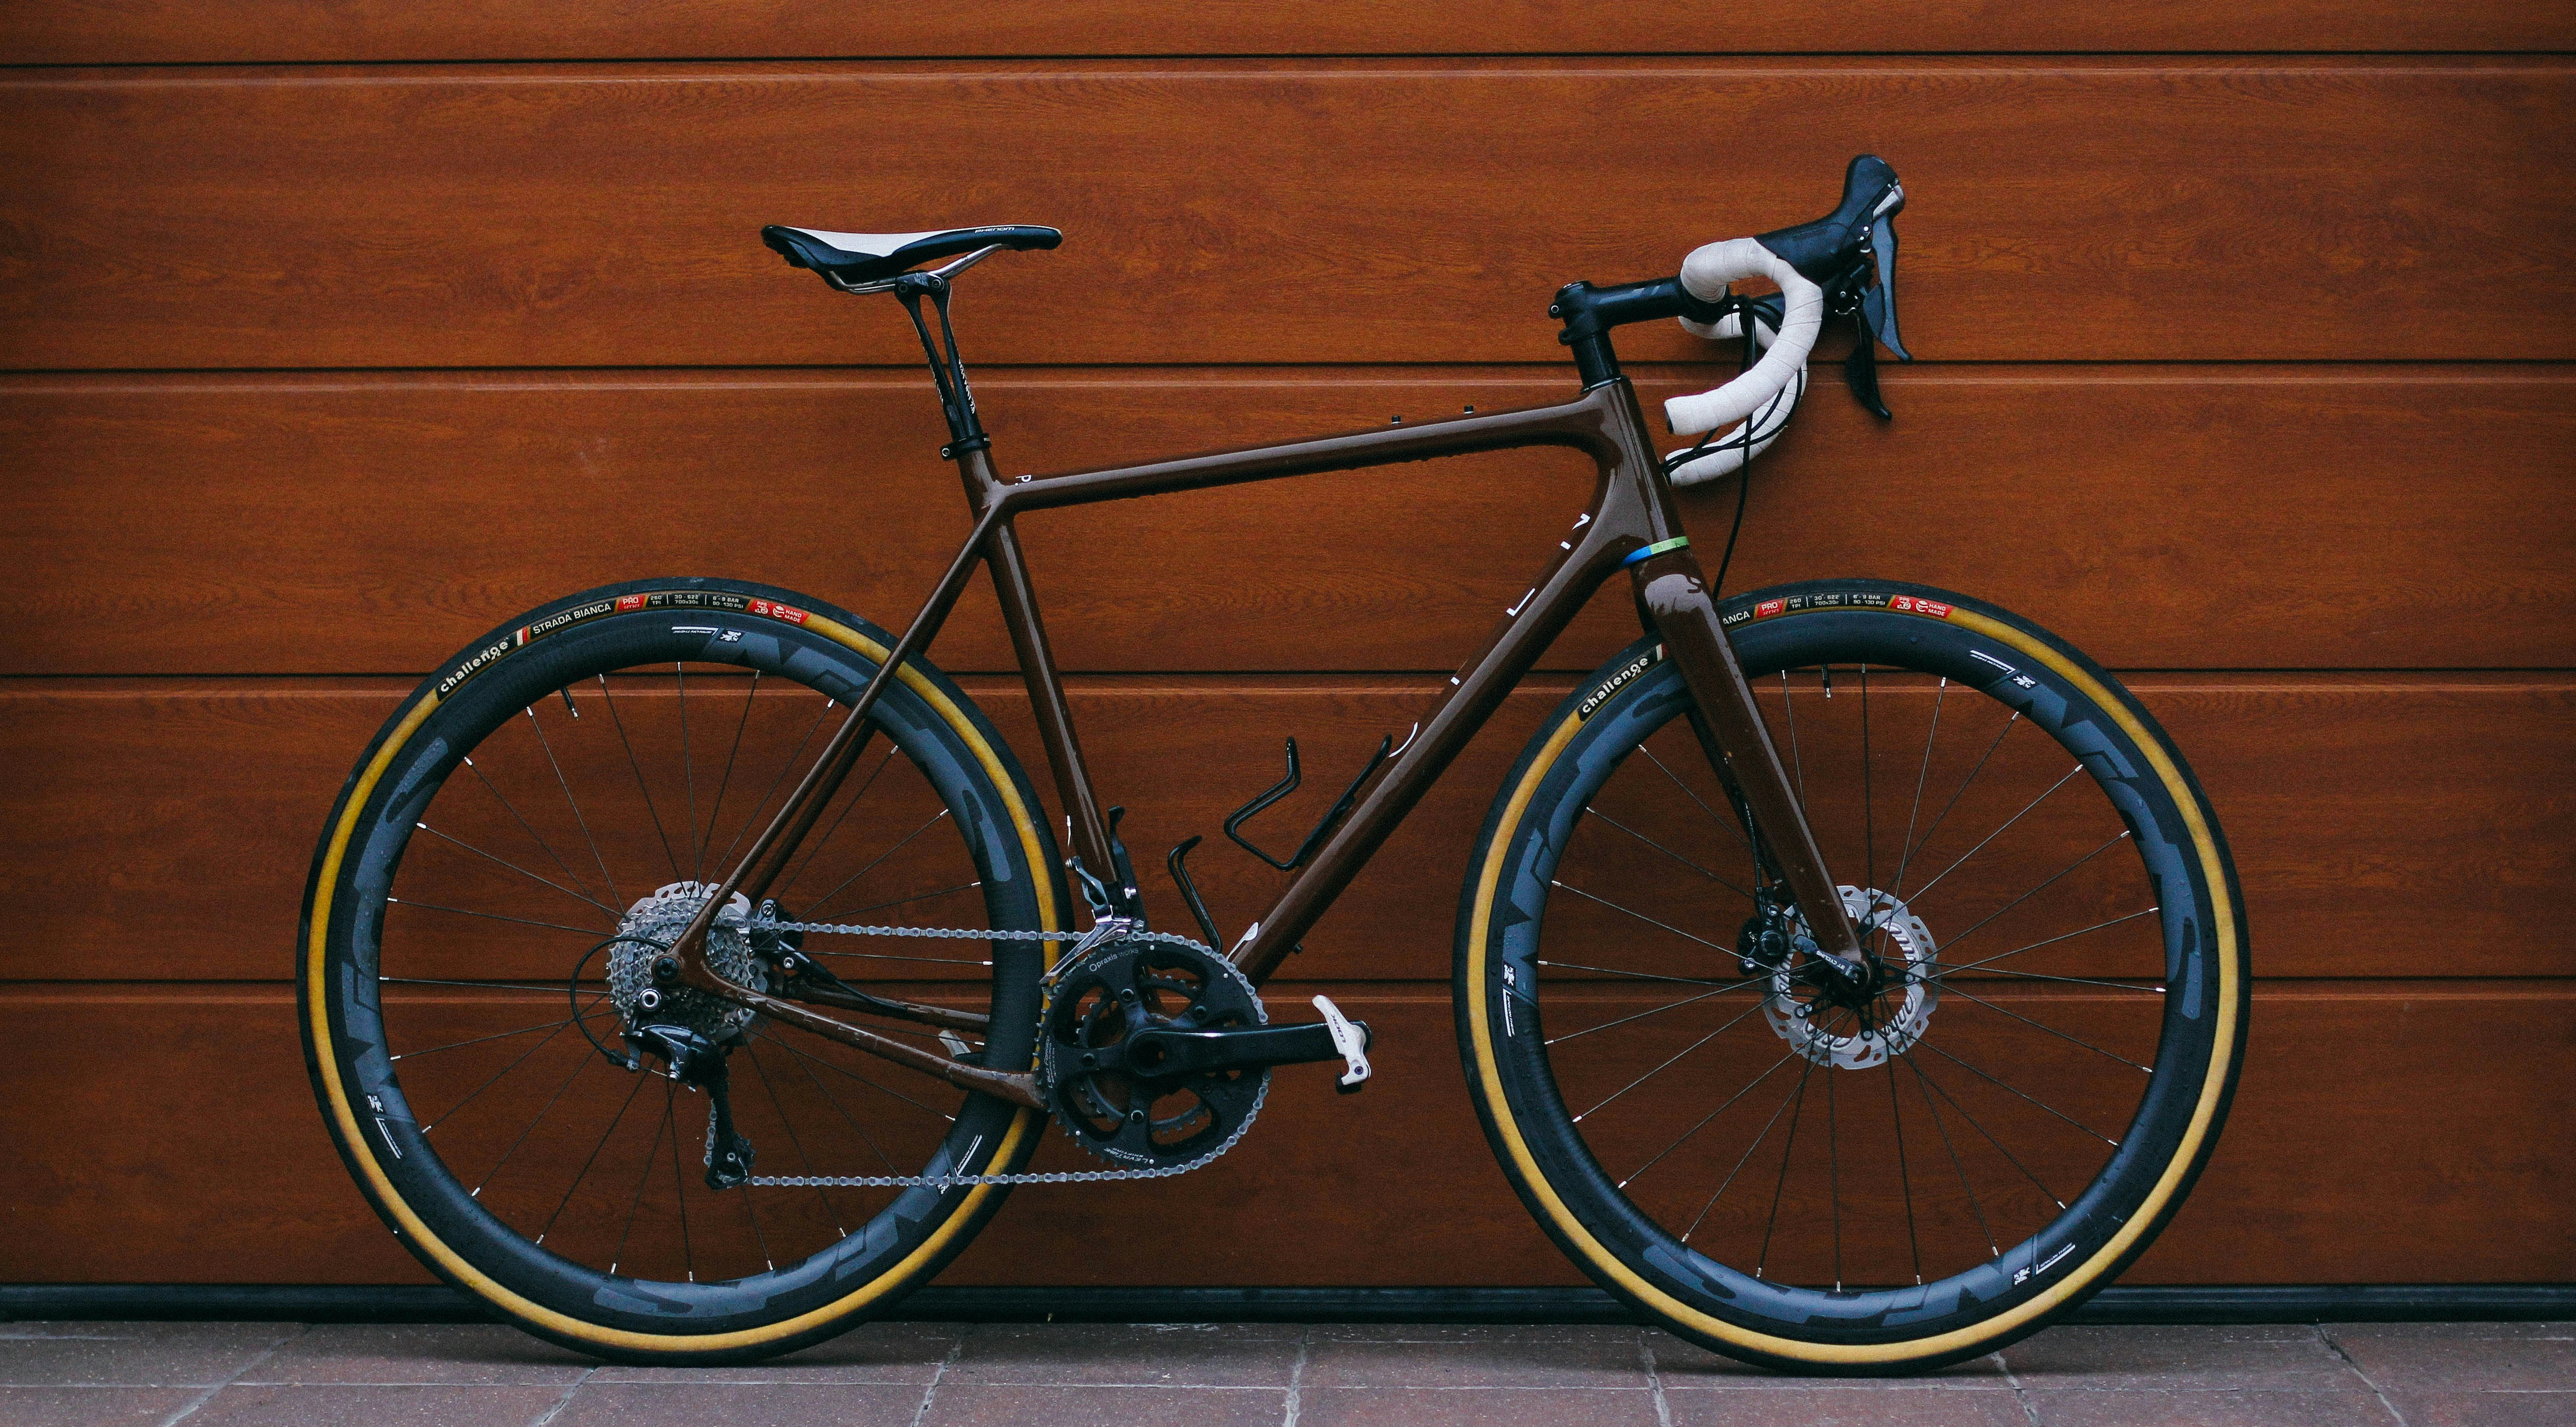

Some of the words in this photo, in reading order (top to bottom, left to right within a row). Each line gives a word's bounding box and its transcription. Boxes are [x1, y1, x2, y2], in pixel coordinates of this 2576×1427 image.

[623, 597, 639, 605] PRO
[1761, 601, 1778, 610] PRO
[533, 615, 572, 634] STRADA
[573, 603, 611, 619] BIANCA
[784, 615, 801, 623] MADE
[785, 609, 802, 618] HAND
[1722, 611, 1750, 625] ANCA
[440, 641, 508, 692] challenge
[1582, 658, 1648, 713] challenge
[1096, 953, 1118, 969] praxis
[1816, 951, 1837, 965] CYCLING
[1330, 1014, 1346, 1043] LOOK
